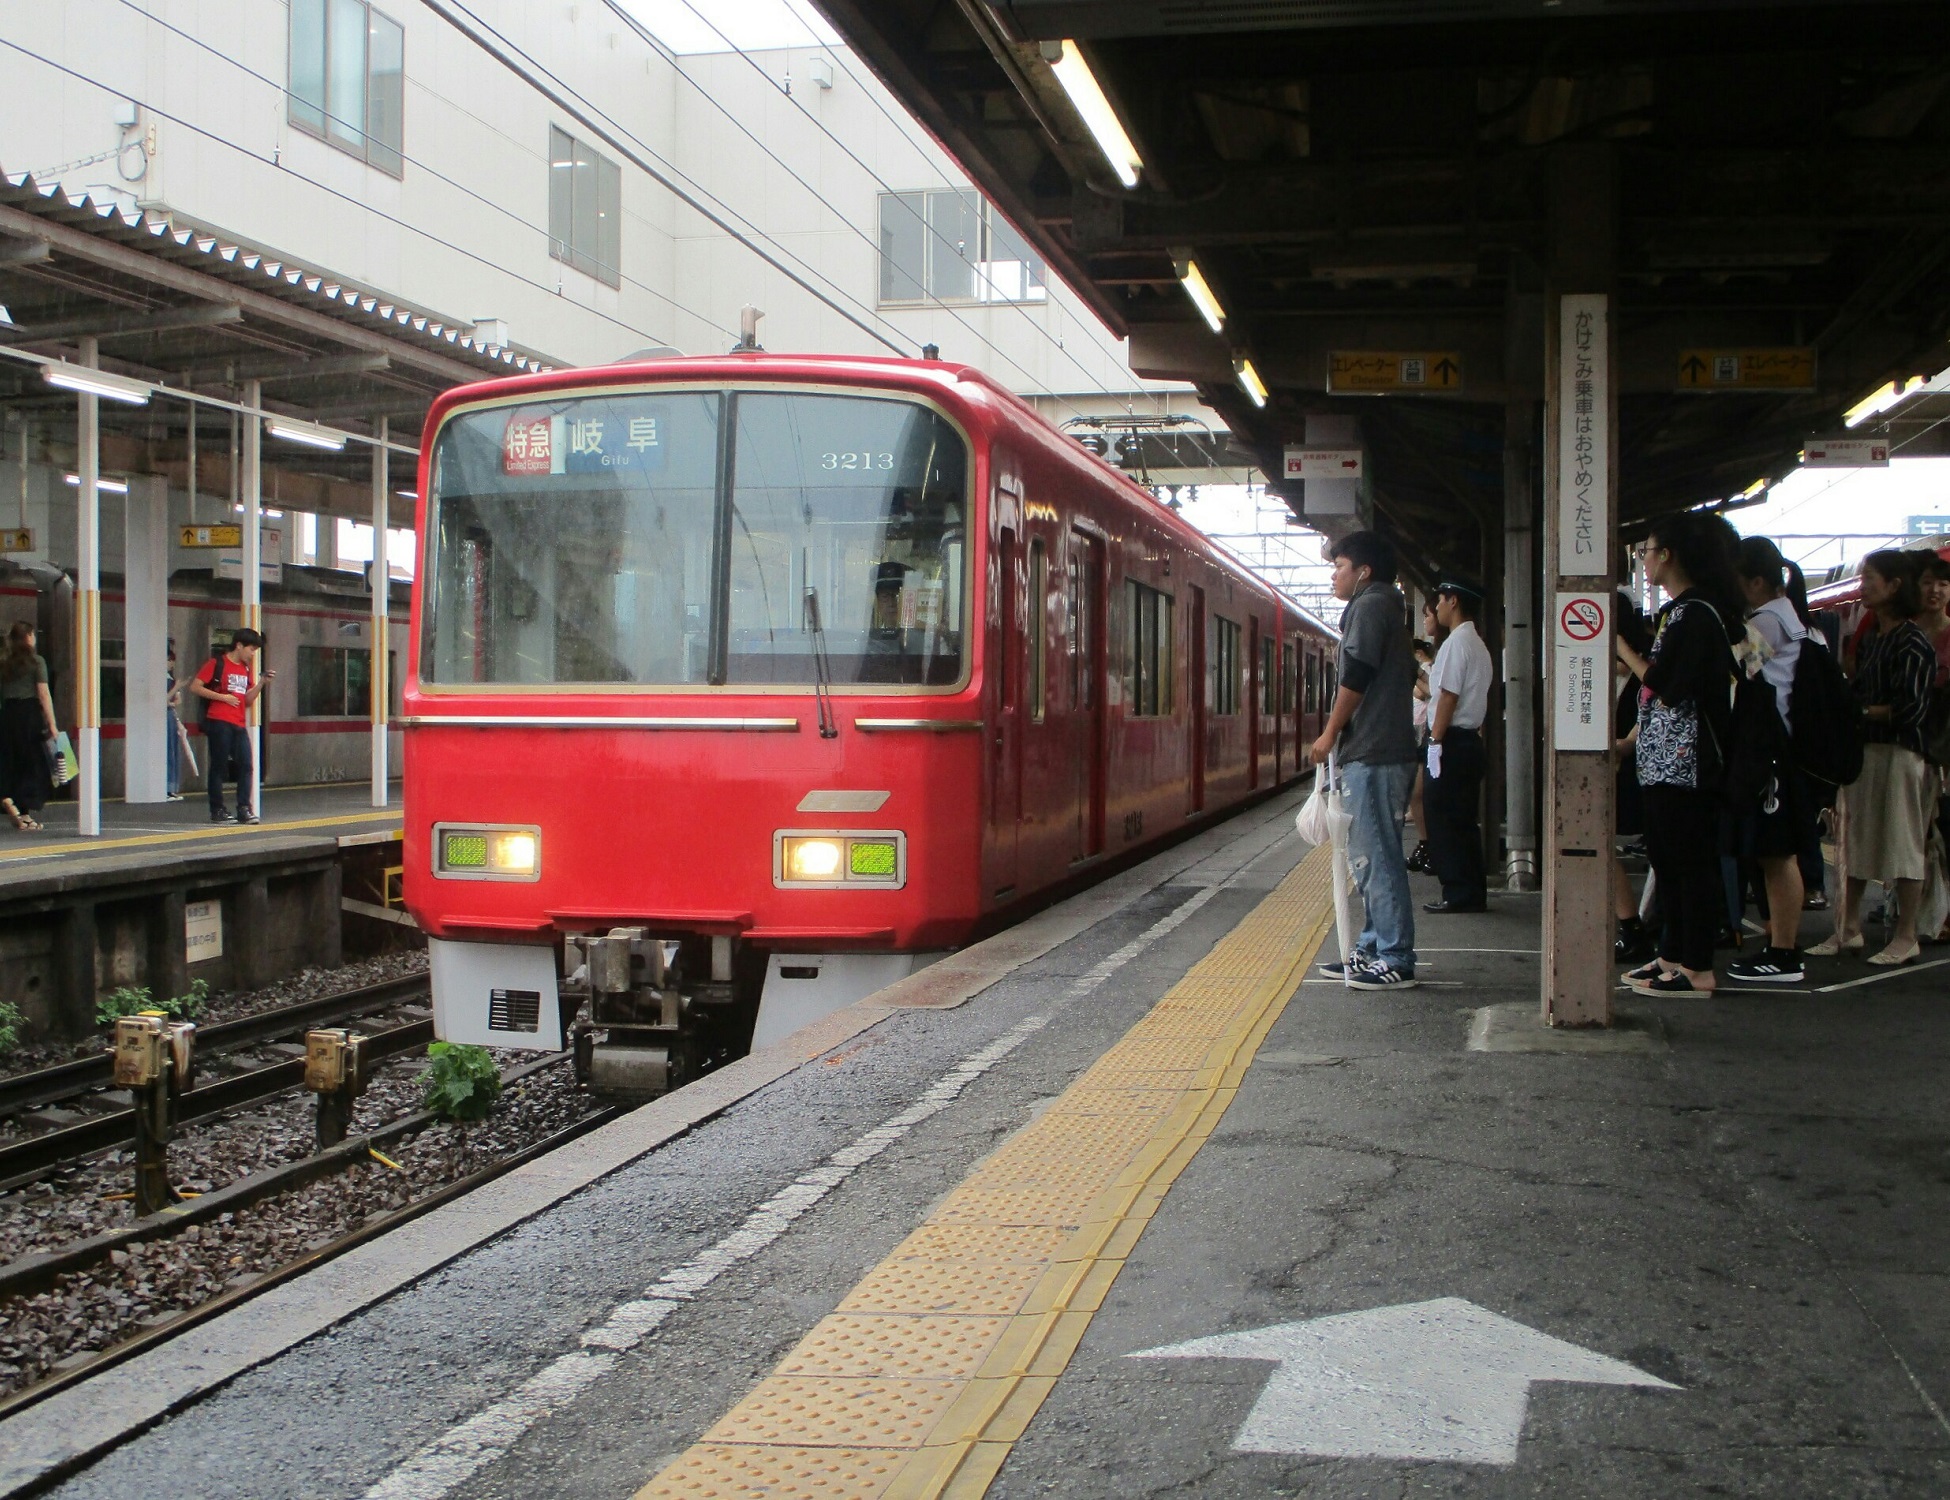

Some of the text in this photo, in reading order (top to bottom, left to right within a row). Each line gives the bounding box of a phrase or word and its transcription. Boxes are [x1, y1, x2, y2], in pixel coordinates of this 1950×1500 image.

[1333, 358, 1396, 372] エレベーター
[506, 422, 550, 459] 特急
[572, 417, 659, 455] 岐阜
[1575, 309, 1593, 554] かけこみ乗車はおやめください
[601, 455, 629, 466] Gifu
[821, 452, 894, 470] 3213
[1567, 655, 1577, 713] No Smoking
[1580, 656, 1593, 724] 終日構内禁煙
